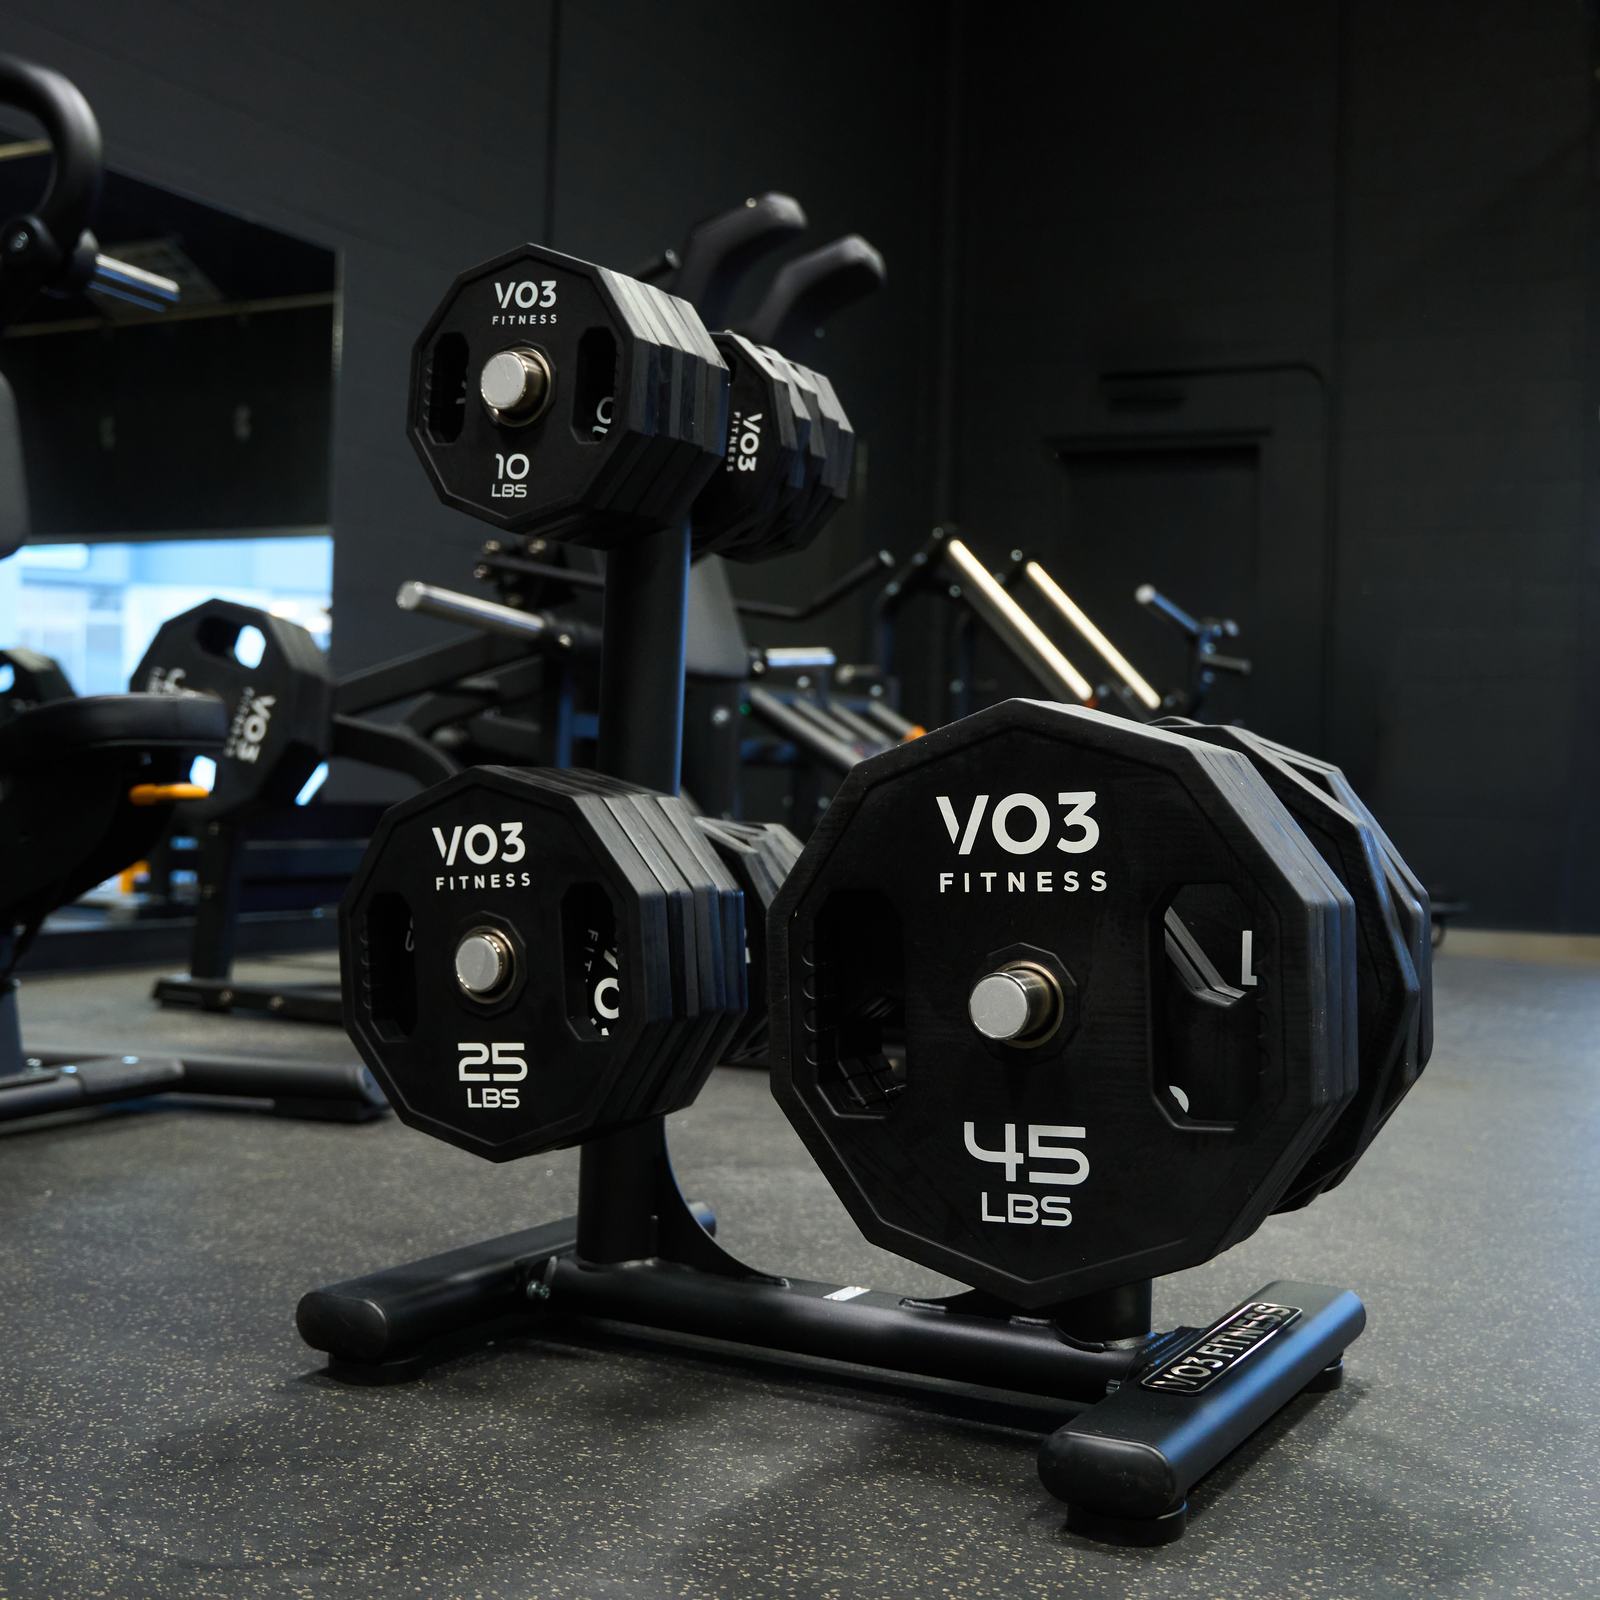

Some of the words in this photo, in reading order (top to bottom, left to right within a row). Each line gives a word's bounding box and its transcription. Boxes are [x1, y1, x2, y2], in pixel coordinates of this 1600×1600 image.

[495, 280, 557, 308] VO3
[492, 313, 558, 325] FITNESS
[737, 412, 763, 472] VO3
[495, 453, 530, 480] 10
[491, 483, 528, 498] LBS
[935, 790, 1100, 855] VO3
[431, 821, 526, 866] VO3
[435, 872, 531, 891] FITNESS
[939, 870, 1107, 893] FITNESS
[457, 1042, 528, 1082] 25
[466, 1087, 520, 1109] LBS
[963, 1121, 1090, 1185] 45
[980, 1191, 1073, 1227] LBS
[1152, 1356, 1223, 1386] VO3
[1196, 1304, 1291, 1358] FITNESS
